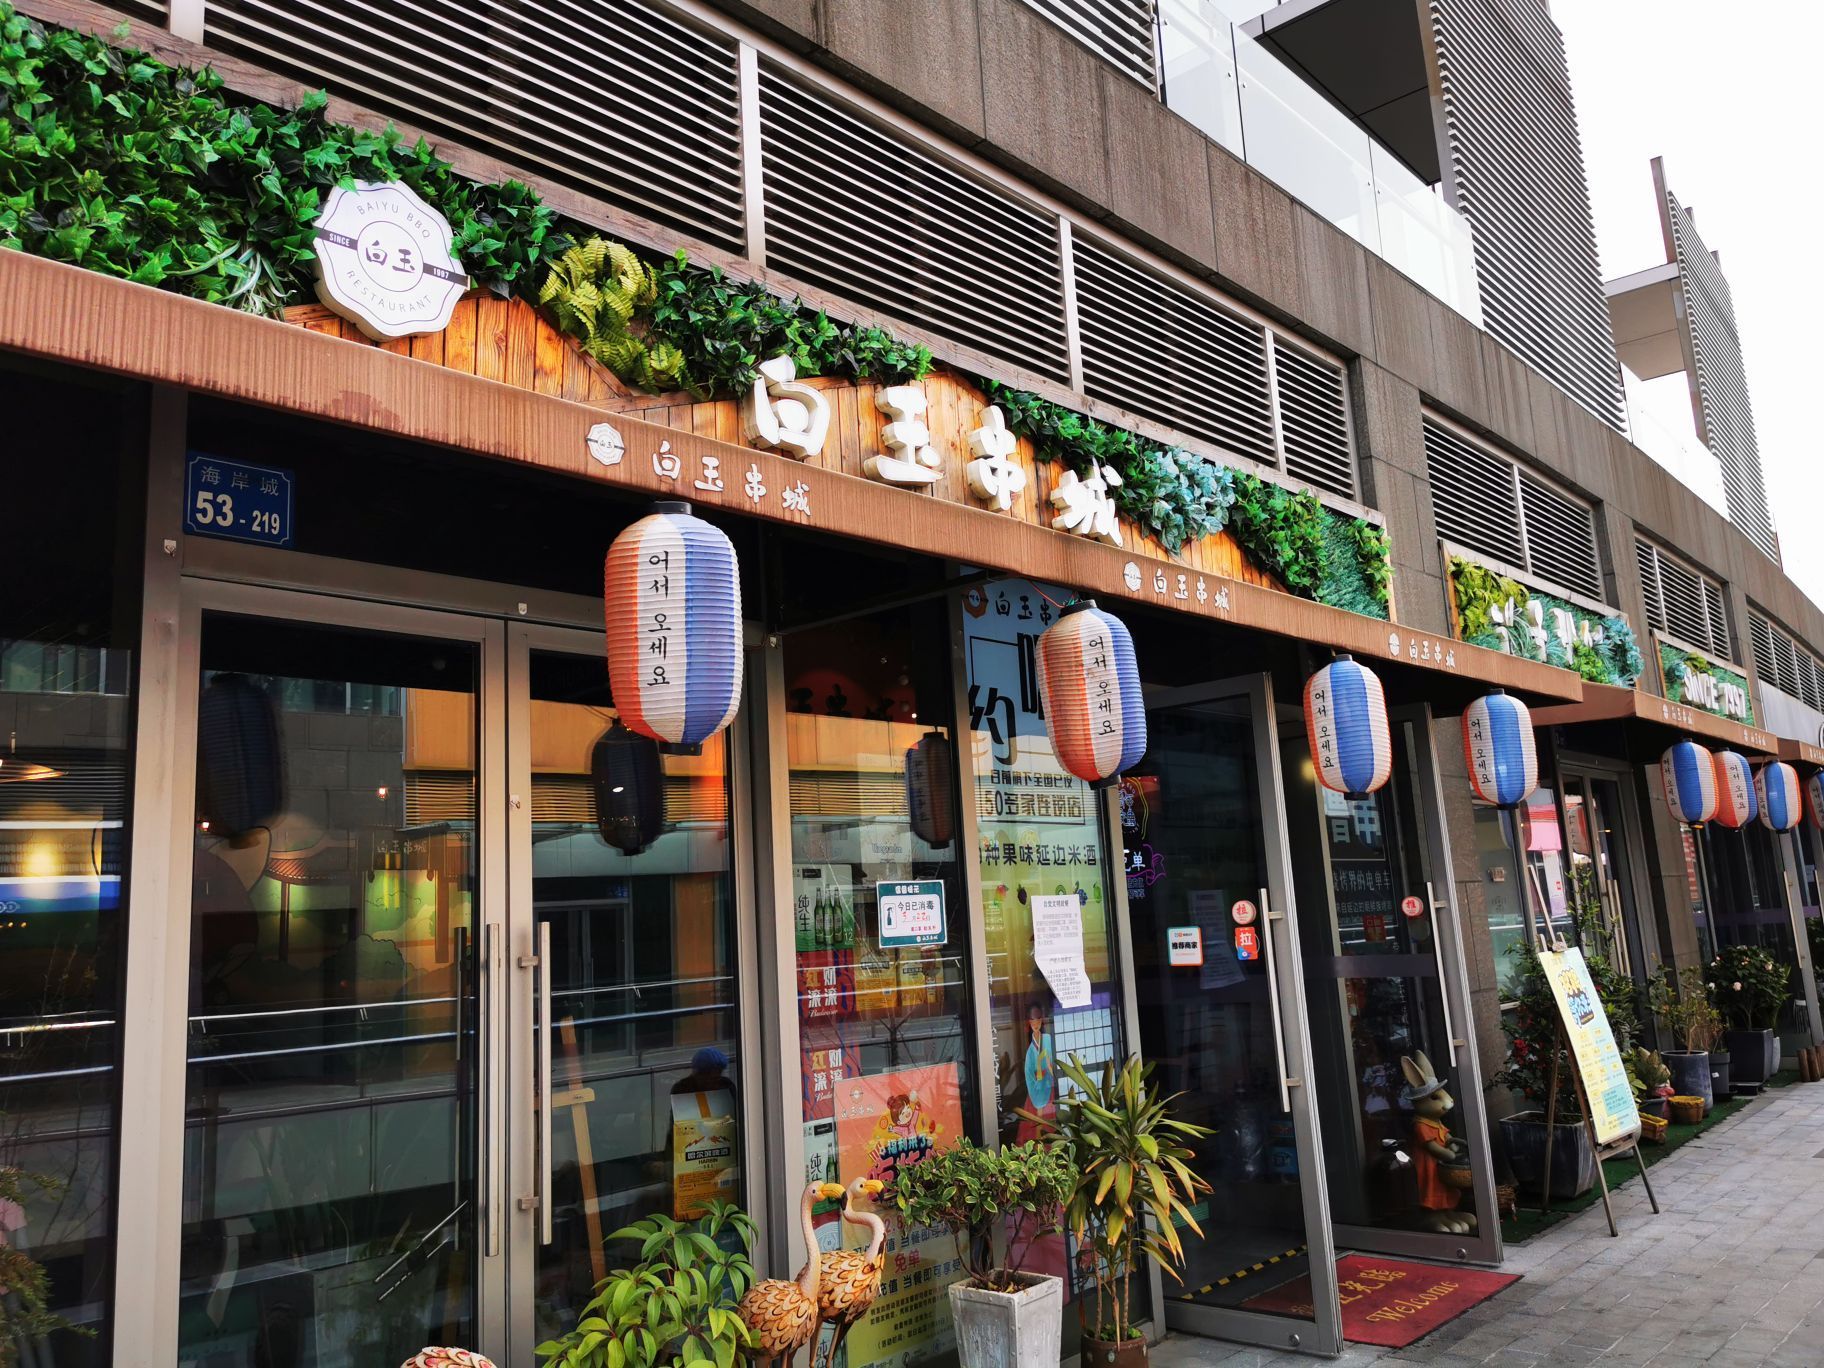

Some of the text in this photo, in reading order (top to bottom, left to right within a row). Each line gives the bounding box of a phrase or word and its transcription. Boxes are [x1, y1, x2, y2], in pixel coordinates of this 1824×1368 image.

[357, 201, 399, 216] BAIYU
[329, 232, 351, 247] SINCE
[365, 239, 416, 274] 白玉
[433, 267, 450, 280] 1997
[346, 270, 432, 313] RESTAURANT
[743, 353, 1123, 547] 白玉串城
[201, 465, 280, 496] 海岸城
[652, 440, 811, 516] 白玉串城
[1153, 568, 1230, 612] 白玉串城
[646, 550, 672, 687] 어서 오세요
[1409, 638, 1456, 668] 白玉串城
[1089, 635, 1116, 737] 어서 오세요
[1314, 690, 1335, 769] 어서 오세요
[1471, 718, 1492, 784] 어서 오세요
[979, 843, 1097, 867] 种果味延边米酒
[798, 893, 812, 932] 纯生
[898, 901, 934, 911] 今日已消毒
[1236, 903, 1248, 915] 拉
[1240, 932, 1253, 946] 拉
[894, 1248, 921, 1274] 免单
[1365, 1280, 1459, 1325] Welcome
